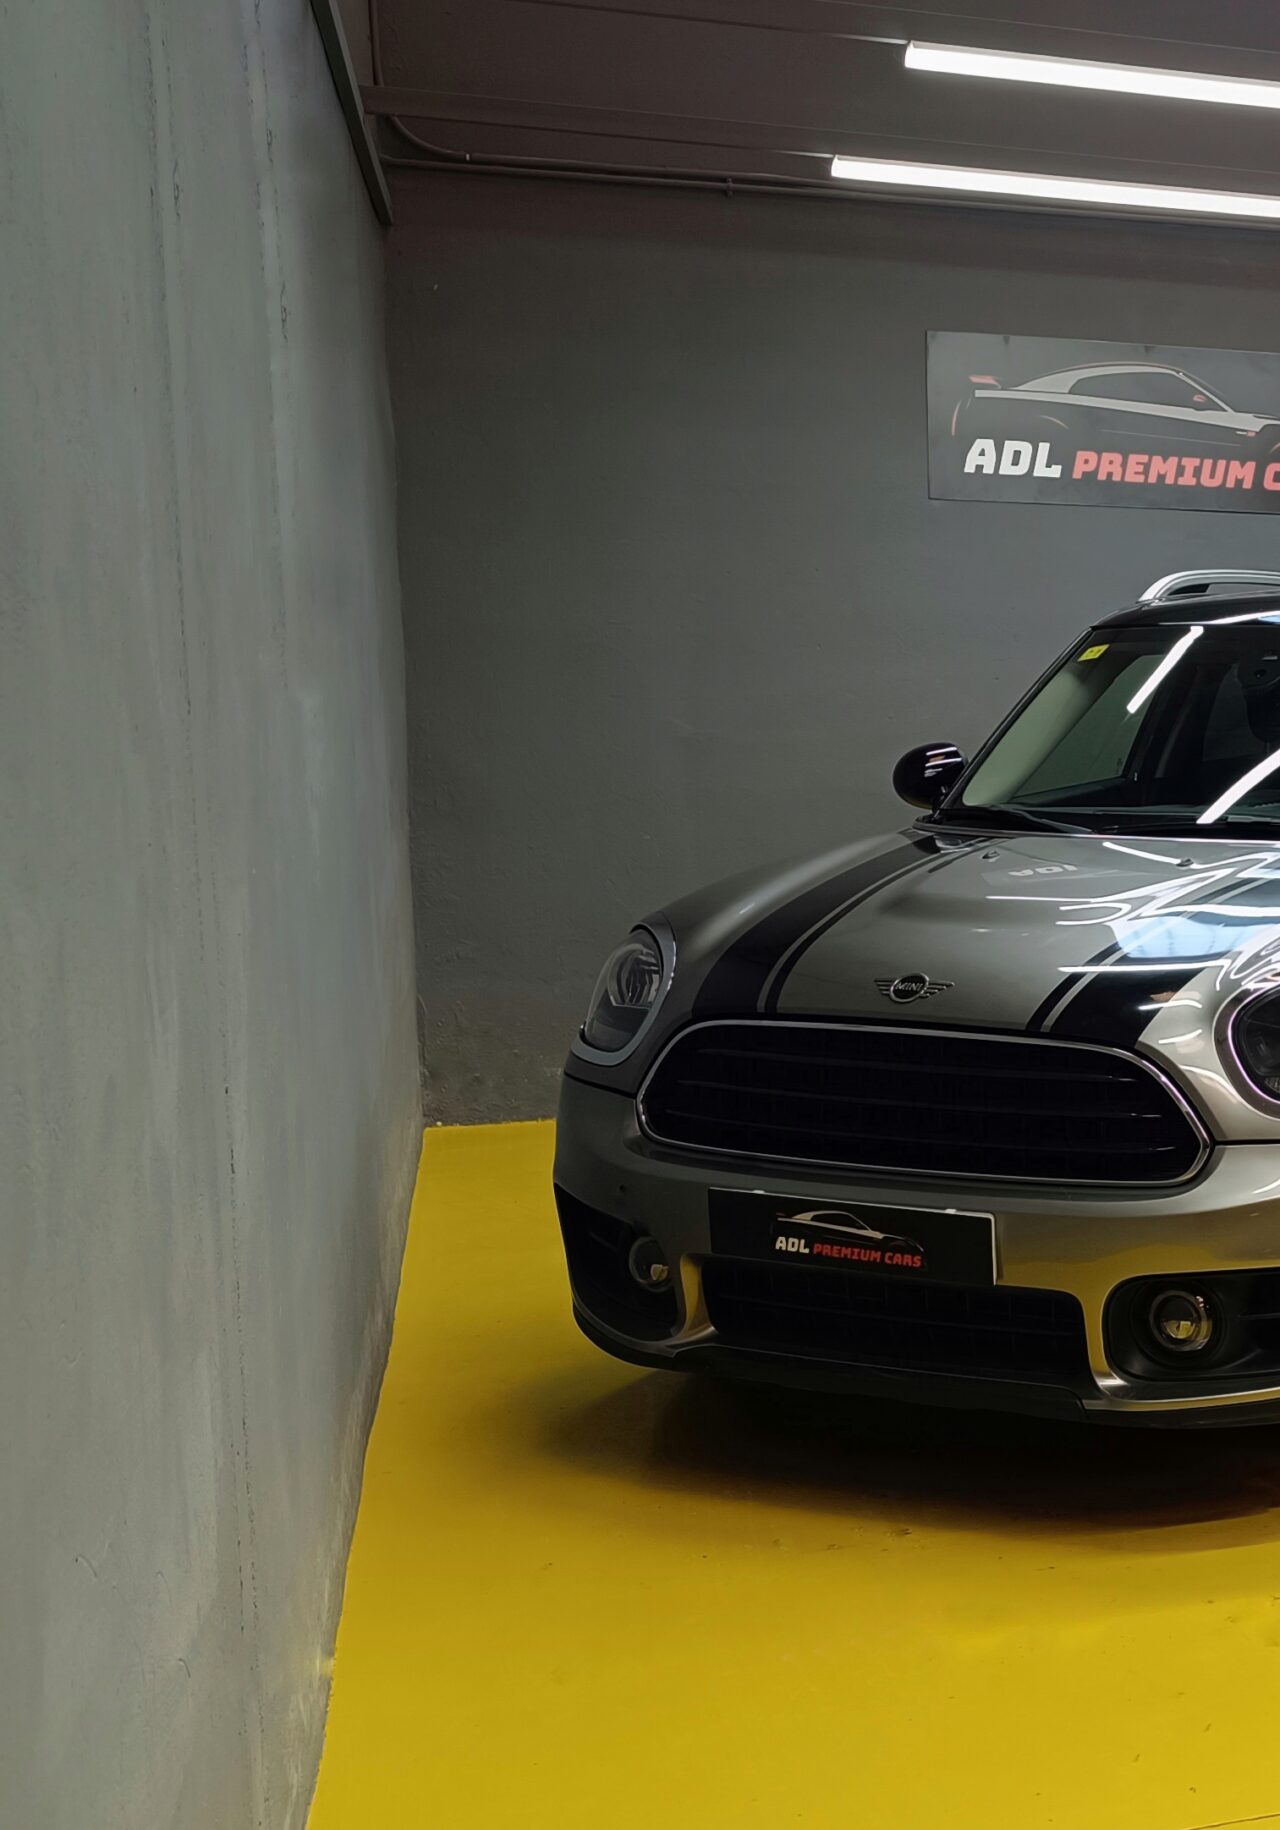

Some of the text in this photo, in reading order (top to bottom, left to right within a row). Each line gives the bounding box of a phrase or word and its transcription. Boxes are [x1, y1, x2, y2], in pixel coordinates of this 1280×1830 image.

[964, 438, 1062, 478] ADL
[1072, 451, 1256, 489] PREMIUM
[895, 982, 923, 991] MINI
[775, 1236, 922, 1267] ADL PREMIUM CARS
